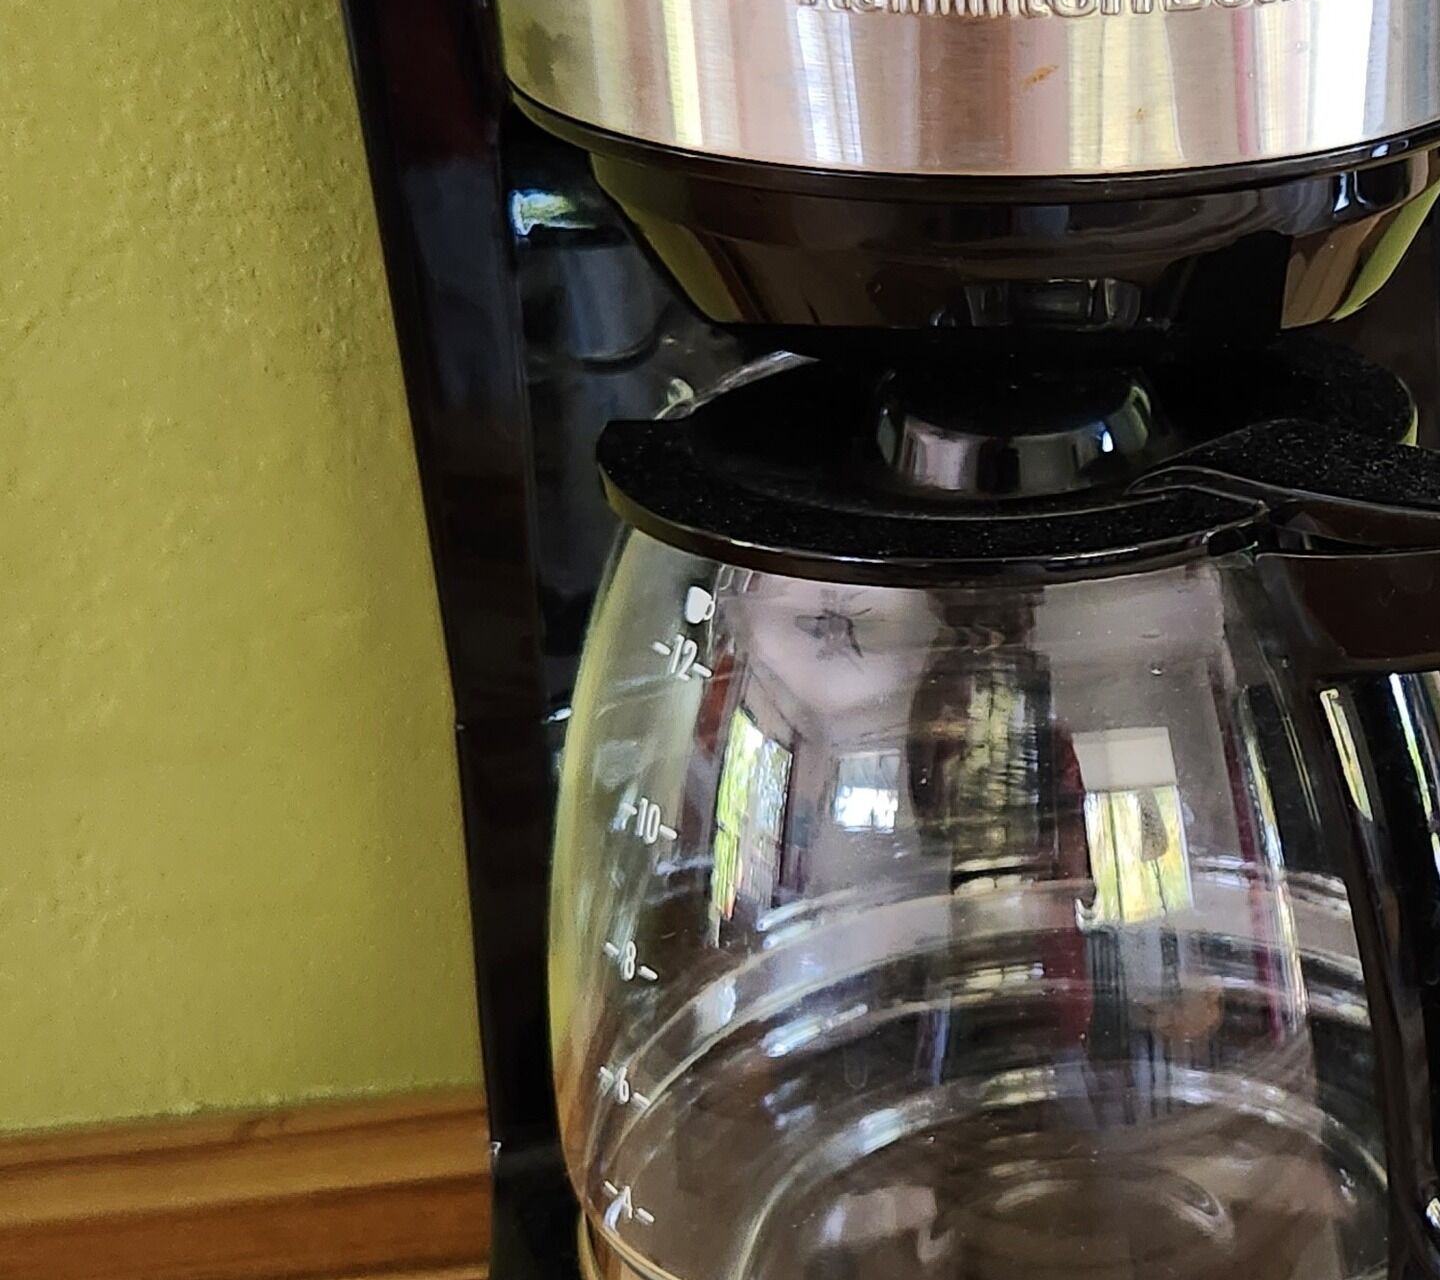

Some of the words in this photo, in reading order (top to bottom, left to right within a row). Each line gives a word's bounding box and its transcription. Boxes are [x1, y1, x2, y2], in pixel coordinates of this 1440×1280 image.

[667, 633, 699, 682] 12
[635, 796, 661, 845] 10
[622, 940, 636, 981] 8
